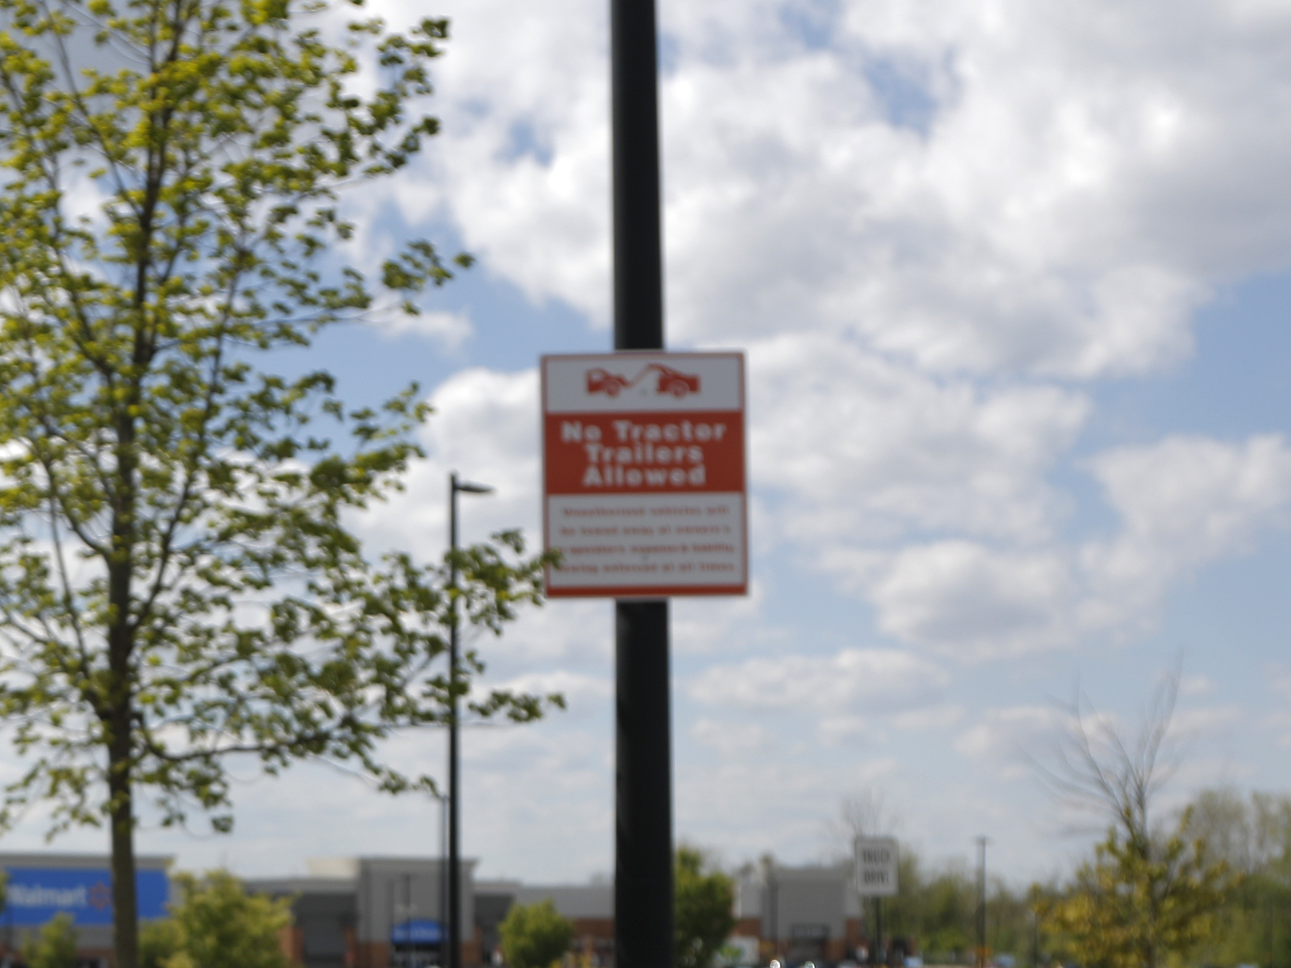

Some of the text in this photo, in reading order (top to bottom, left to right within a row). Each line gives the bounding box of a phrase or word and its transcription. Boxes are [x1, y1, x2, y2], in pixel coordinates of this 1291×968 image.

[561, 419, 727, 443] No Tractor
[584, 440, 704, 465] Trailers
[582, 463, 706, 487] Allowed
